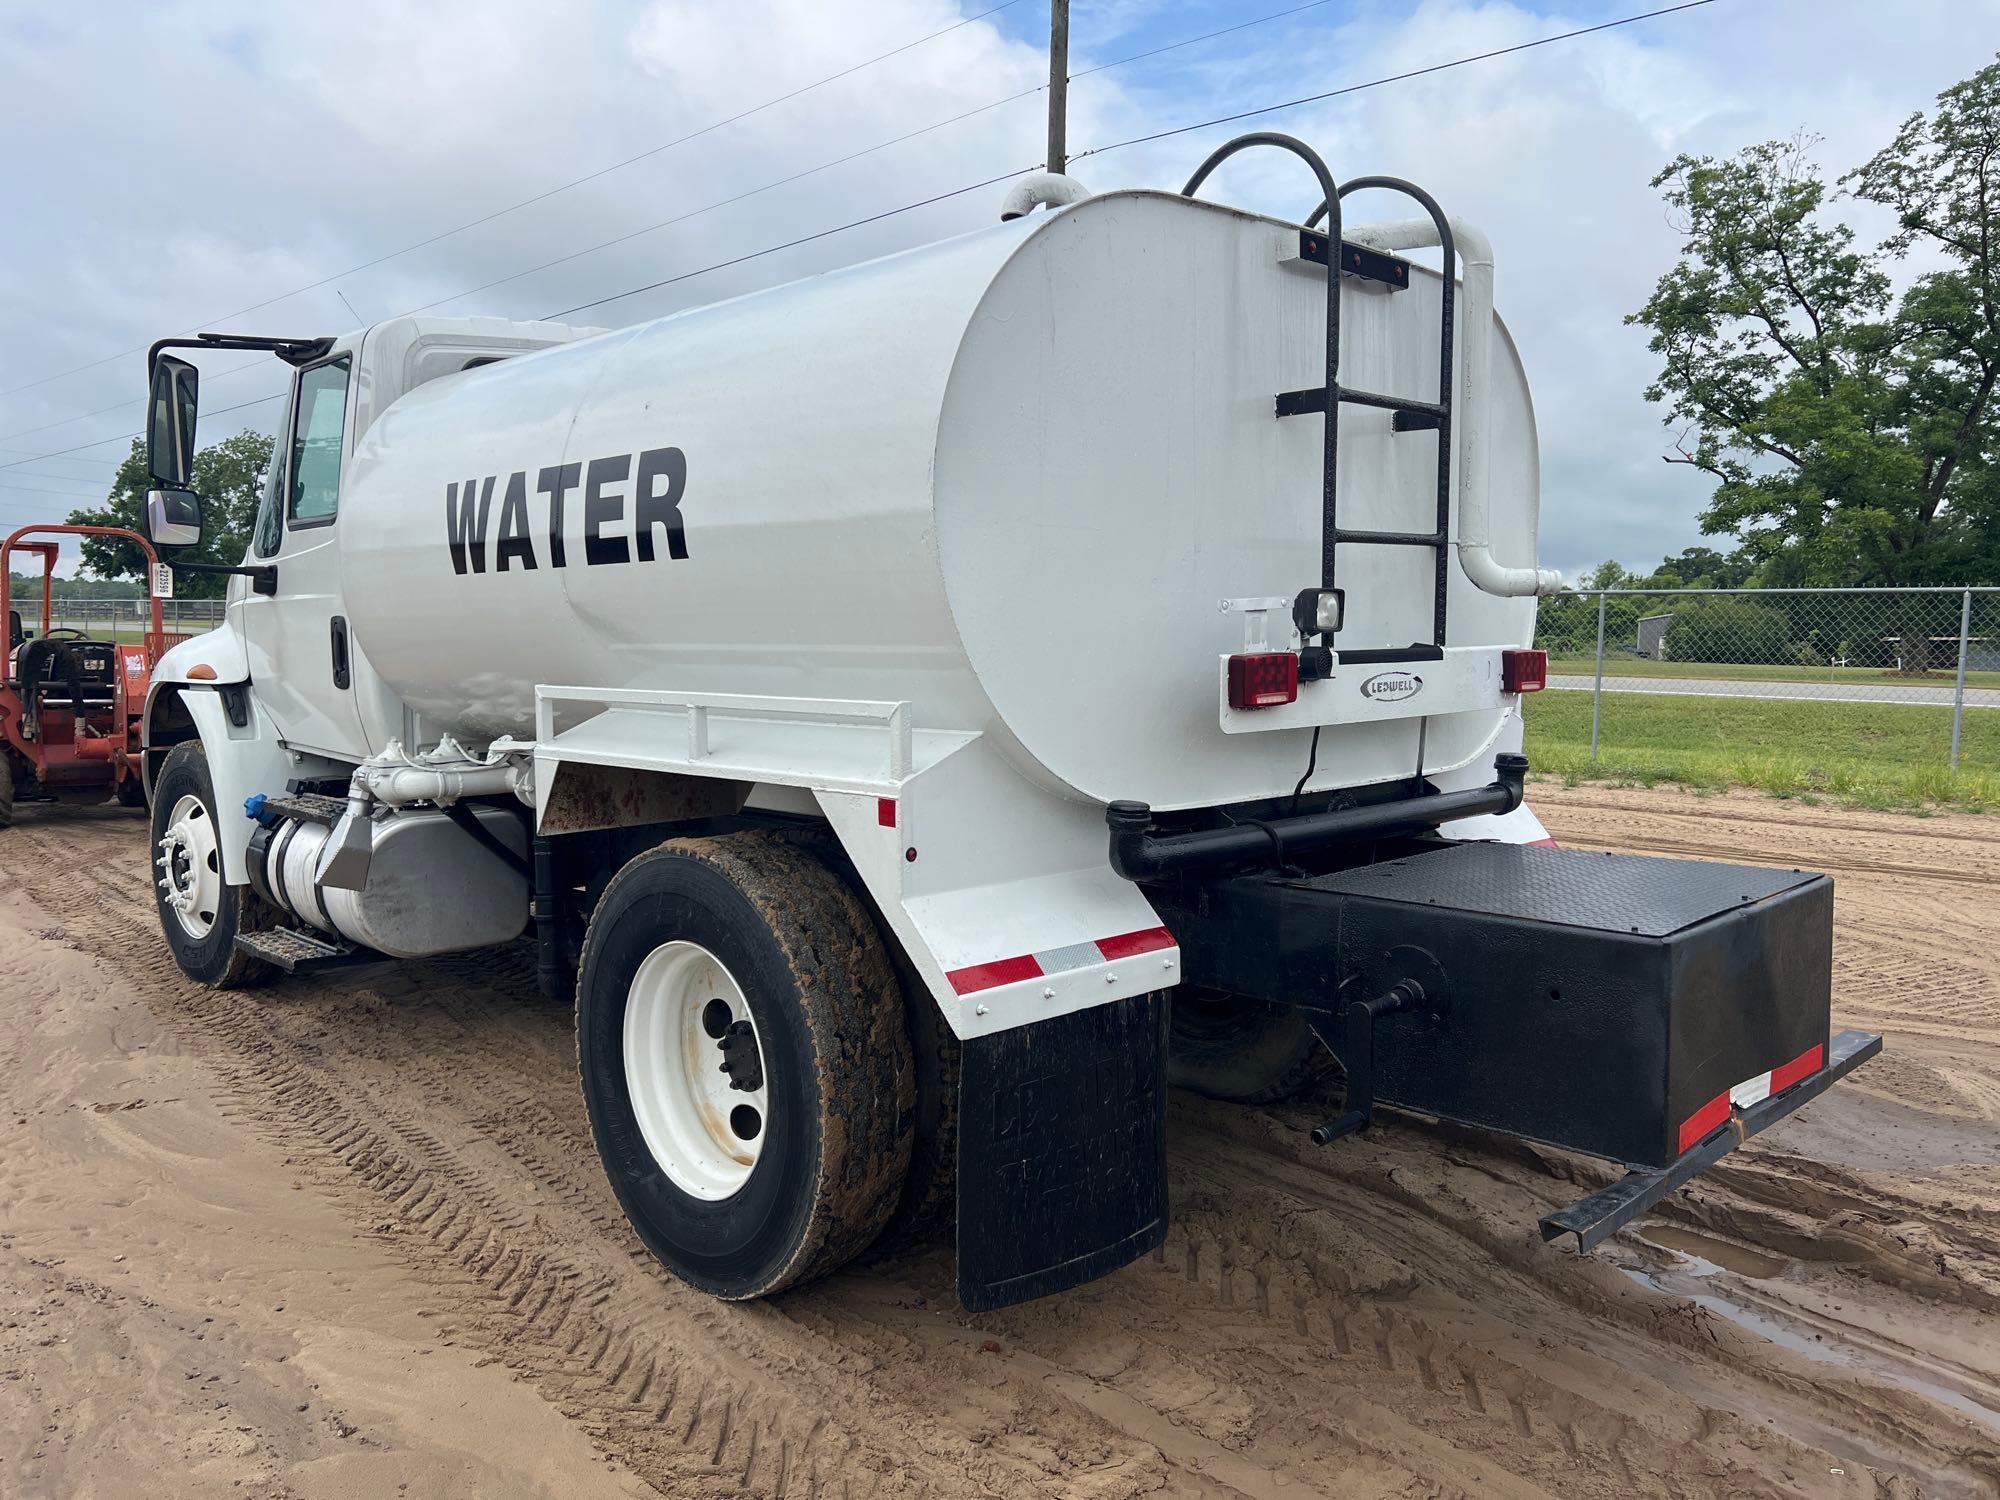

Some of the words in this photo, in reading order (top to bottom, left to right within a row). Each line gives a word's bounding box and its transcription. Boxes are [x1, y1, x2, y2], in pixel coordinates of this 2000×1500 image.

[446, 446, 690, 575] WATER
[159, 570, 169, 594] 223596
[1371, 680, 1414, 694] LEDWELL
